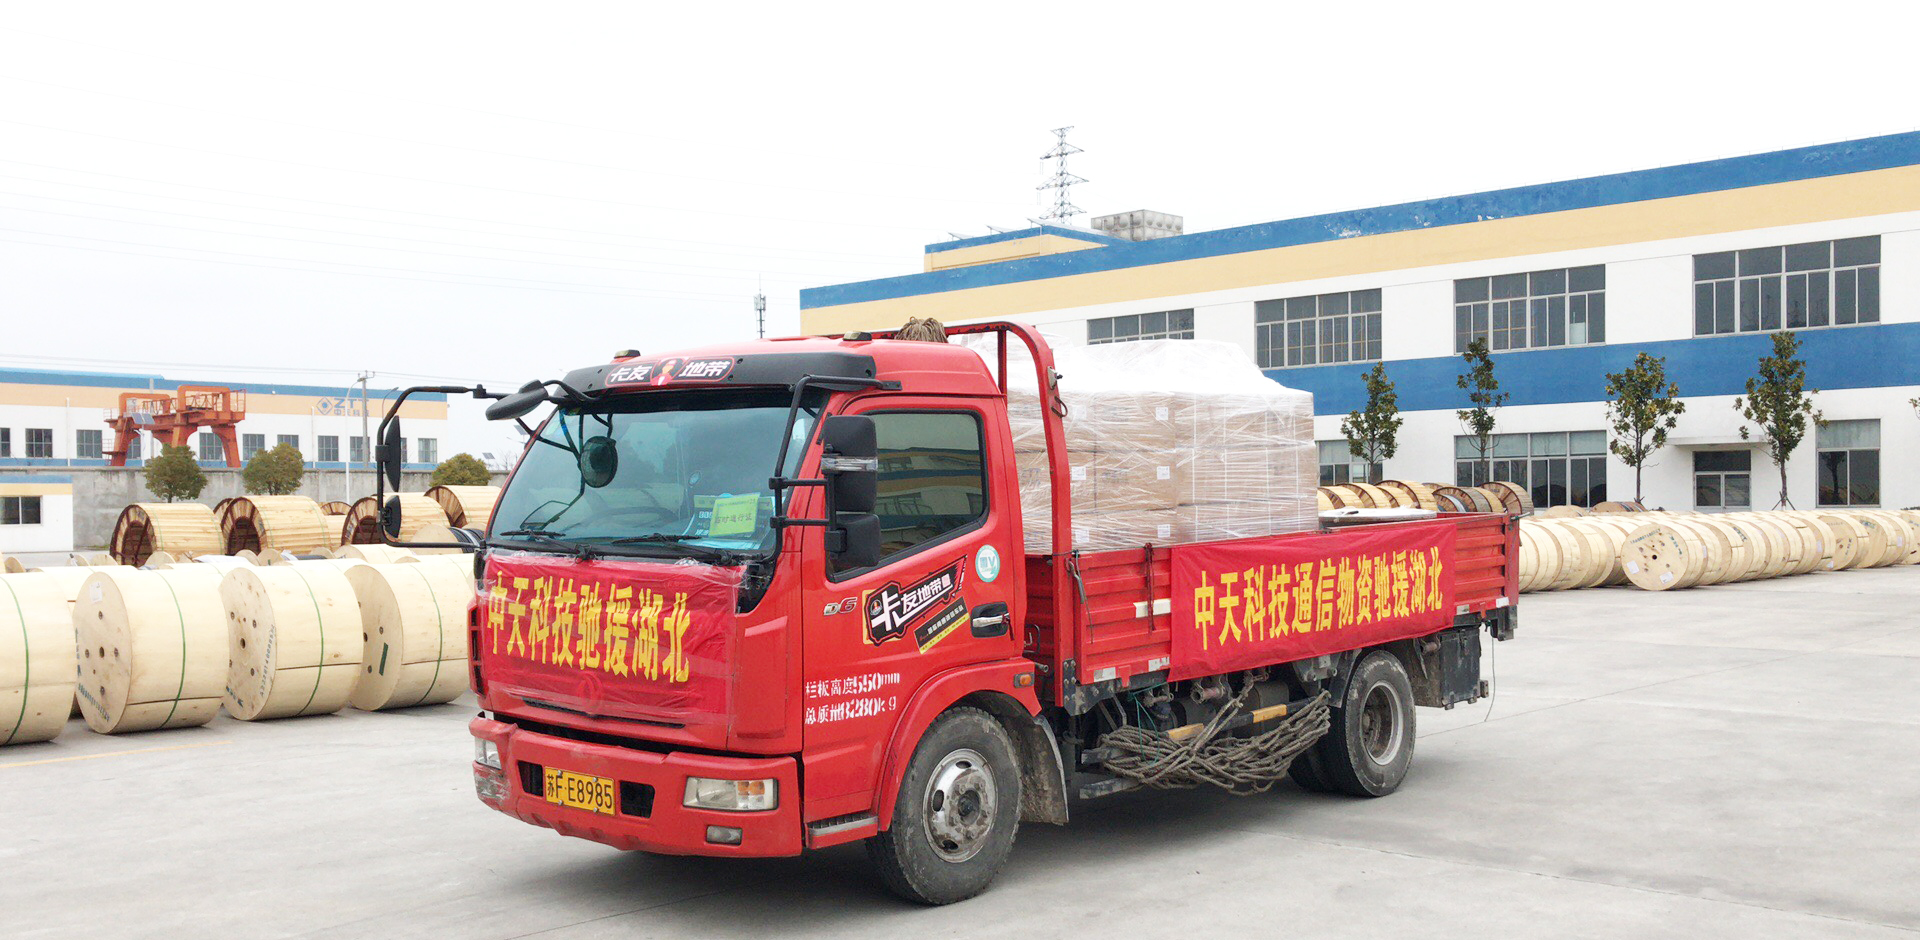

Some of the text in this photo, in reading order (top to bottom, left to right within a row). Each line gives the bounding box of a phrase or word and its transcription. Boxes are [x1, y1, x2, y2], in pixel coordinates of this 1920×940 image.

[611, 361, 730, 382] 卡友 地带
[487, 570, 691, 683] 中天科技驰援湖北
[823, 597, 858, 615] D6
[1194, 546, 1443, 650] 中天科技通信物资驰援湖北
